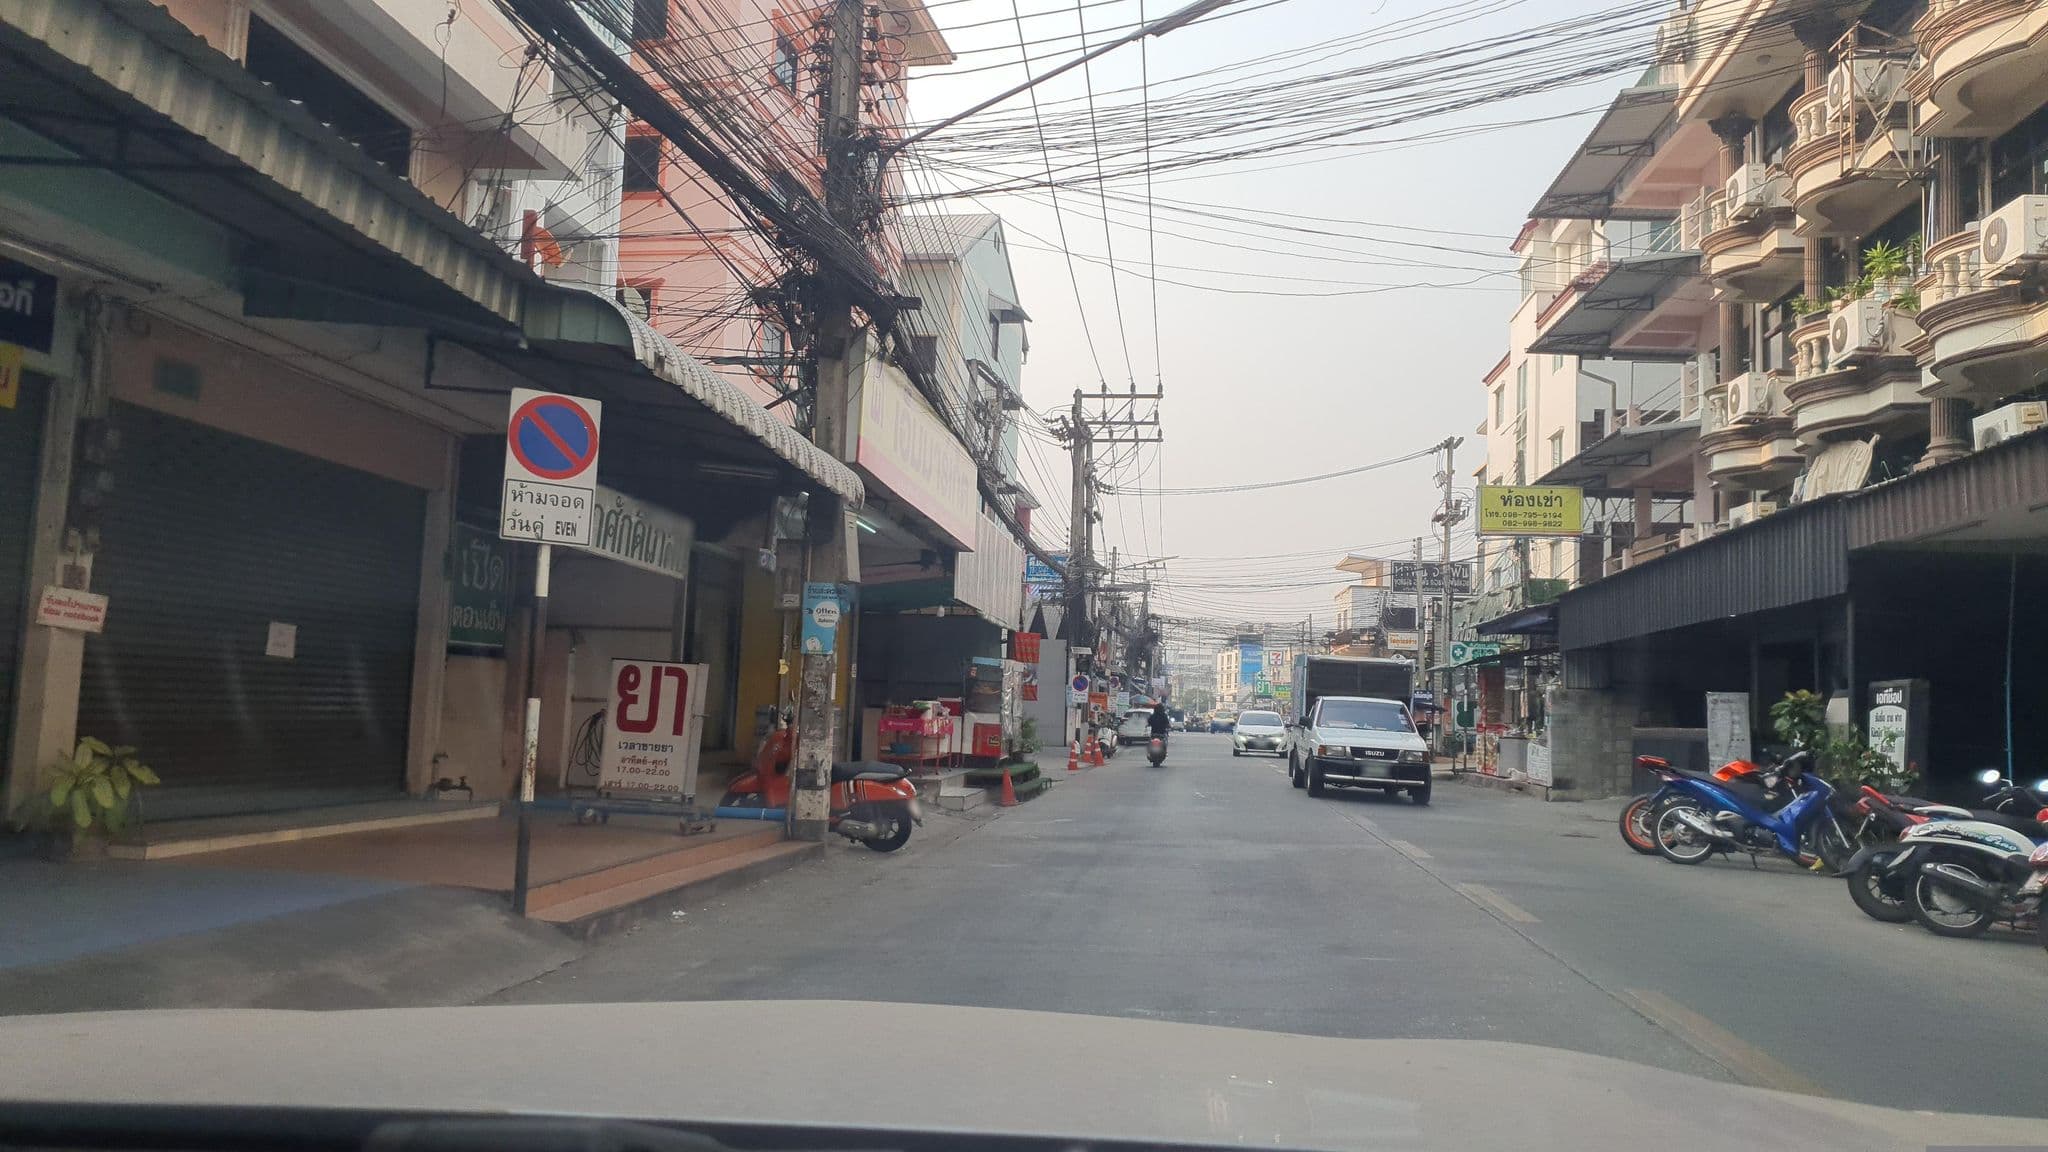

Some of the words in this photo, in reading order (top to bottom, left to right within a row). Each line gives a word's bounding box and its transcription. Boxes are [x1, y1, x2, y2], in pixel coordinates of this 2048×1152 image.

[511, 482, 585, 510] ห้ามจอด
[1499, 488, 1563, 508] ห้องเช่า
[506, 509, 545, 541] วันคู่
[555, 520, 577, 538] EVEN
[63, 612, 99, 622] notebook
[617, 664, 688, 736] ยา
[617, 766, 671, 777] 17.00-22.00
